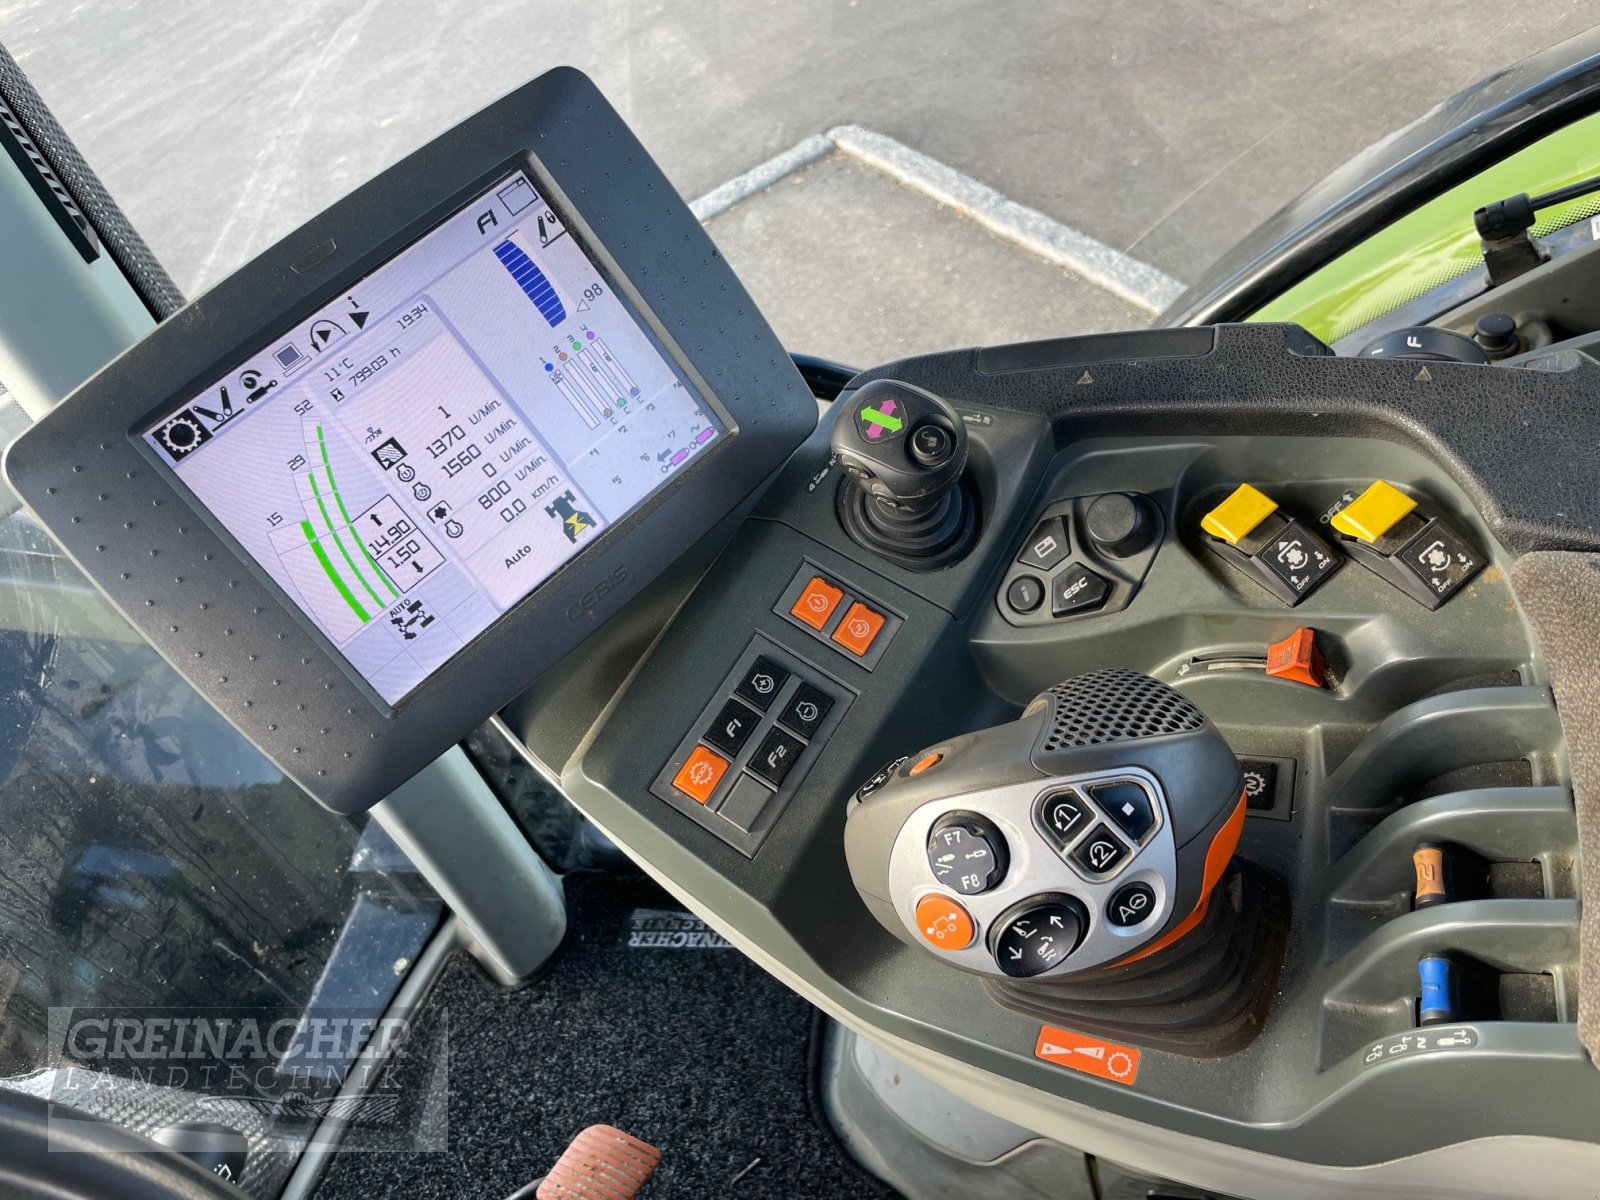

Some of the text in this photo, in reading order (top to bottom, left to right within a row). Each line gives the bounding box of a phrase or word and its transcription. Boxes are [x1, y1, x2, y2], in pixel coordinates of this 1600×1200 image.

[583, 283, 604, 303] 98
[396, 303, 429, 330] 19:34
[349, 346, 401, 387] 799:03 h
[294, 399, 314, 417] 52
[438, 405, 451, 419] 1
[426, 424, 466, 459] 1370
[286, 454, 306, 471] 29
[441, 444, 482, 479] 1560
[482, 462, 497, 478] 0
[478, 480, 512, 510] 800
[809, 484, 816, 492] 4
[500, 475, 559, 523] 0.0 km/h
[266, 512, 283, 527] 15
[1319, 500, 1343, 525] OFF
[368, 519, 411, 556] 14.90
[387, 539, 421, 569] 1.50
[504, 544, 532, 570] Auto
[1318, 556, 1331, 569] ON
[1461, 560, 1473, 572] ON
[1063, 576, 1088, 600] ESC
[1296, 575, 1311, 590] OFF
[1437, 578, 1451, 593] OFF
[389, 598, 411, 619] AUTO
[725, 718, 743, 738] F1
[767, 744, 787, 769] F2
[943, 830, 962, 846] F7
[1095, 844, 1109, 858] 2
[961, 874, 980, 891] F8
[1117, 904, 1136, 923] A
[628, 931, 737, 948] INACHER
